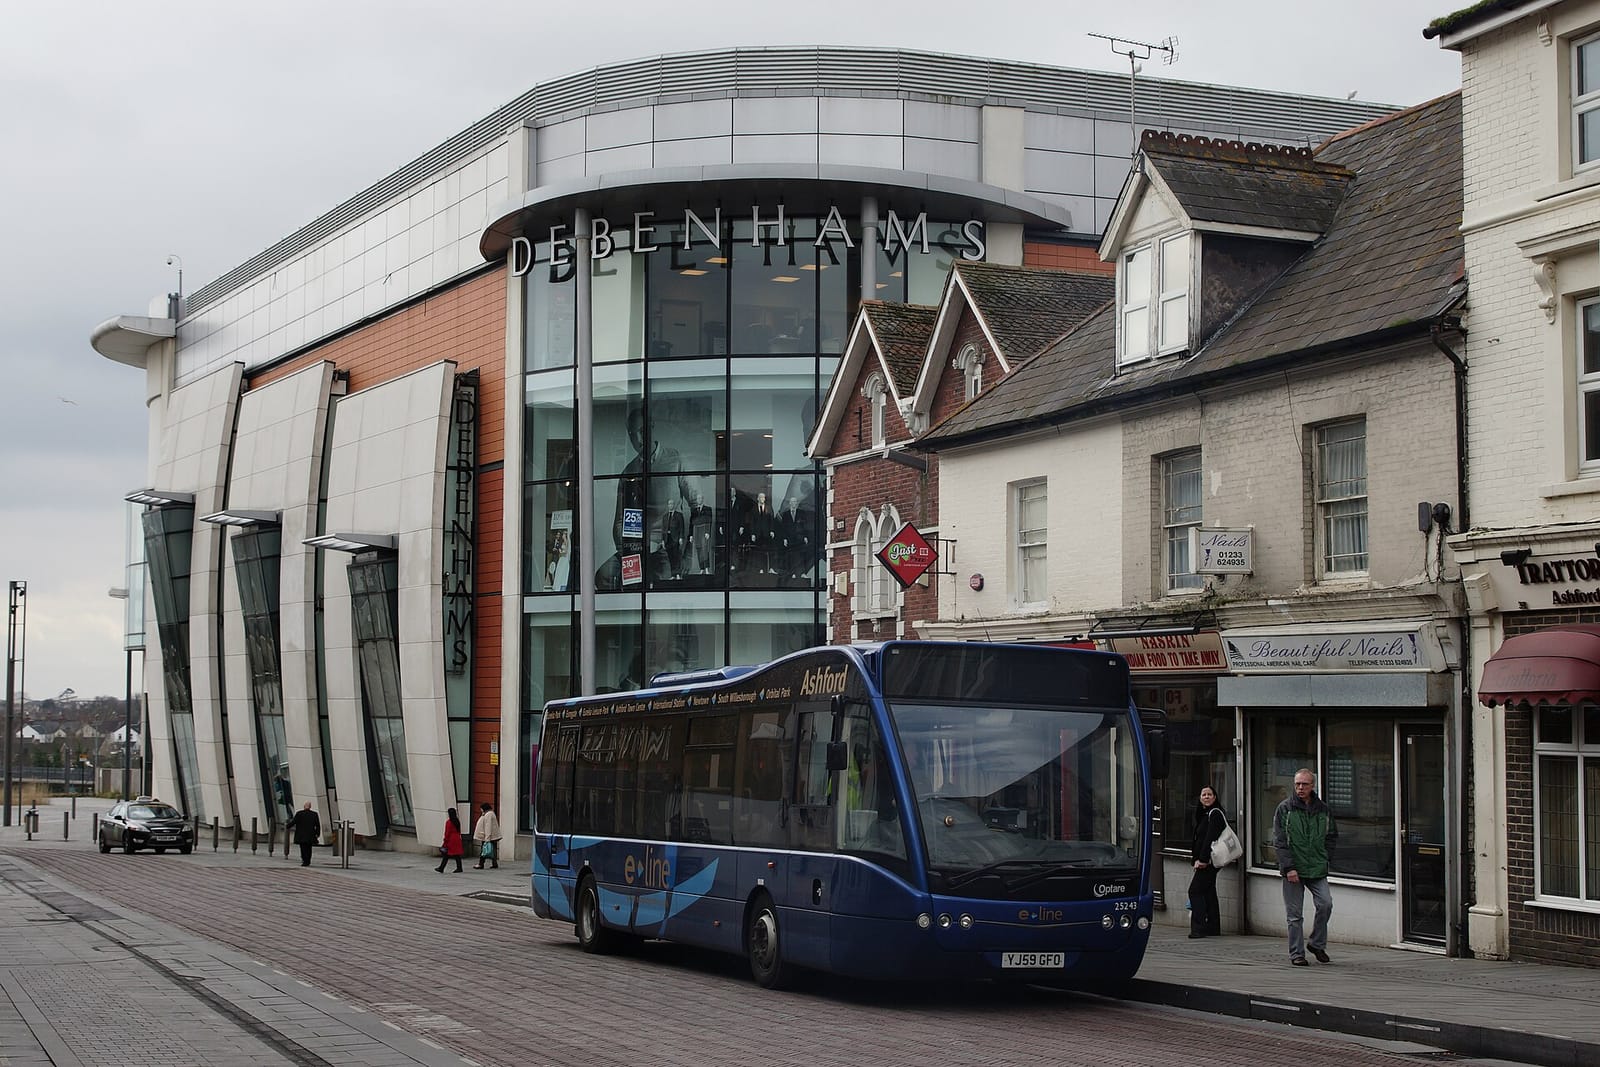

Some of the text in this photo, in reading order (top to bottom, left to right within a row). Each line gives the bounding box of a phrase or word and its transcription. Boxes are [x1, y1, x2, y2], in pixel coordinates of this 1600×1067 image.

[512, 204, 987, 277] DEBENHAMS
[446, 397, 475, 668] DEBENHAMS
[1201, 534, 1248, 547] Nails
[890, 543, 917, 560] Just
[1218, 551, 1243, 559] 01233
[1216, 558, 1246, 566] 624935
[1249, 636, 1404, 662] Beautiful Nails
[1125, 650, 1221, 667] NDIAN FOOD TO TAKE AWAY
[800, 663, 849, 696] Ashford
[766, 688, 780, 700] Orbital
[780, 687, 791, 698] Park
[1096, 884, 1126, 896] Optare
[1114, 902, 1138, 911] 25243
[1007, 954, 1061, 966] YJ59 GFO
